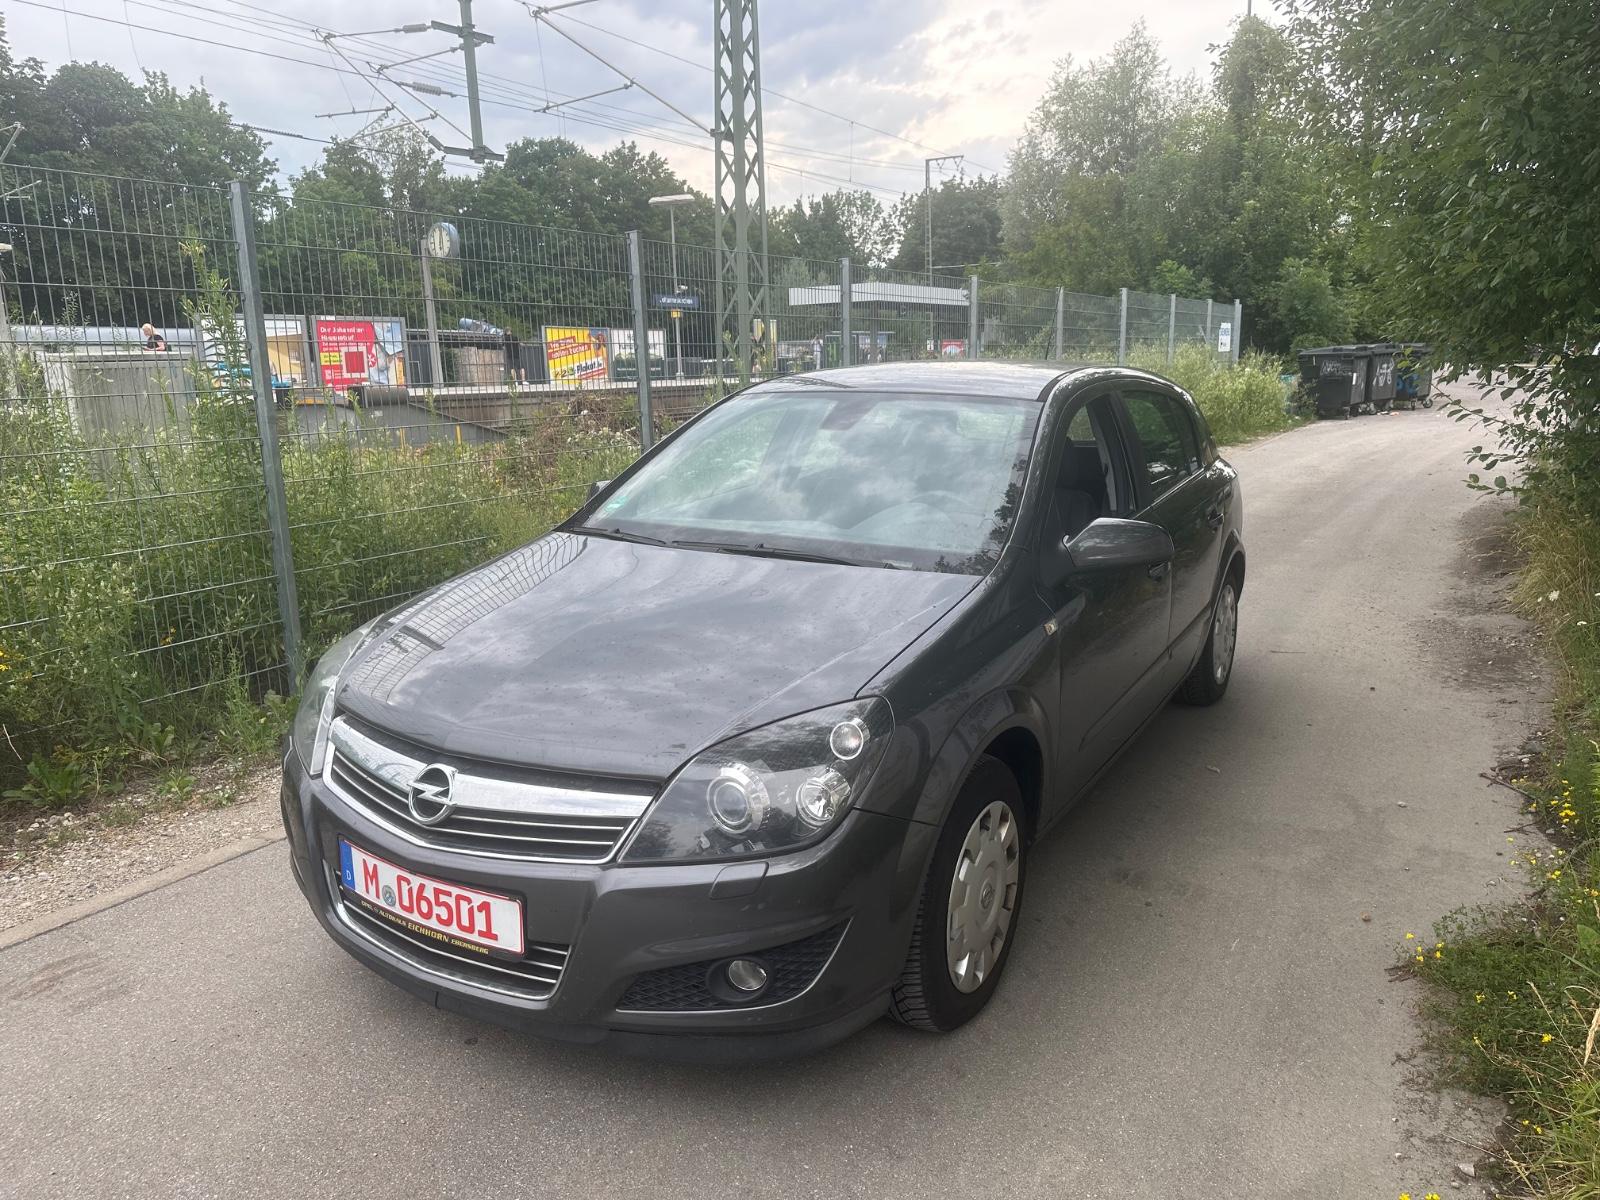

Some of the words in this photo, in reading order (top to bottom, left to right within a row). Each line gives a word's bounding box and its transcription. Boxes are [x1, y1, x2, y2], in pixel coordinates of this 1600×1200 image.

[346, 870, 352, 881] D
[362, 858, 381, 900] M
[396, 874, 499, 942] 06501
[408, 922, 449, 943] EICHHORN
